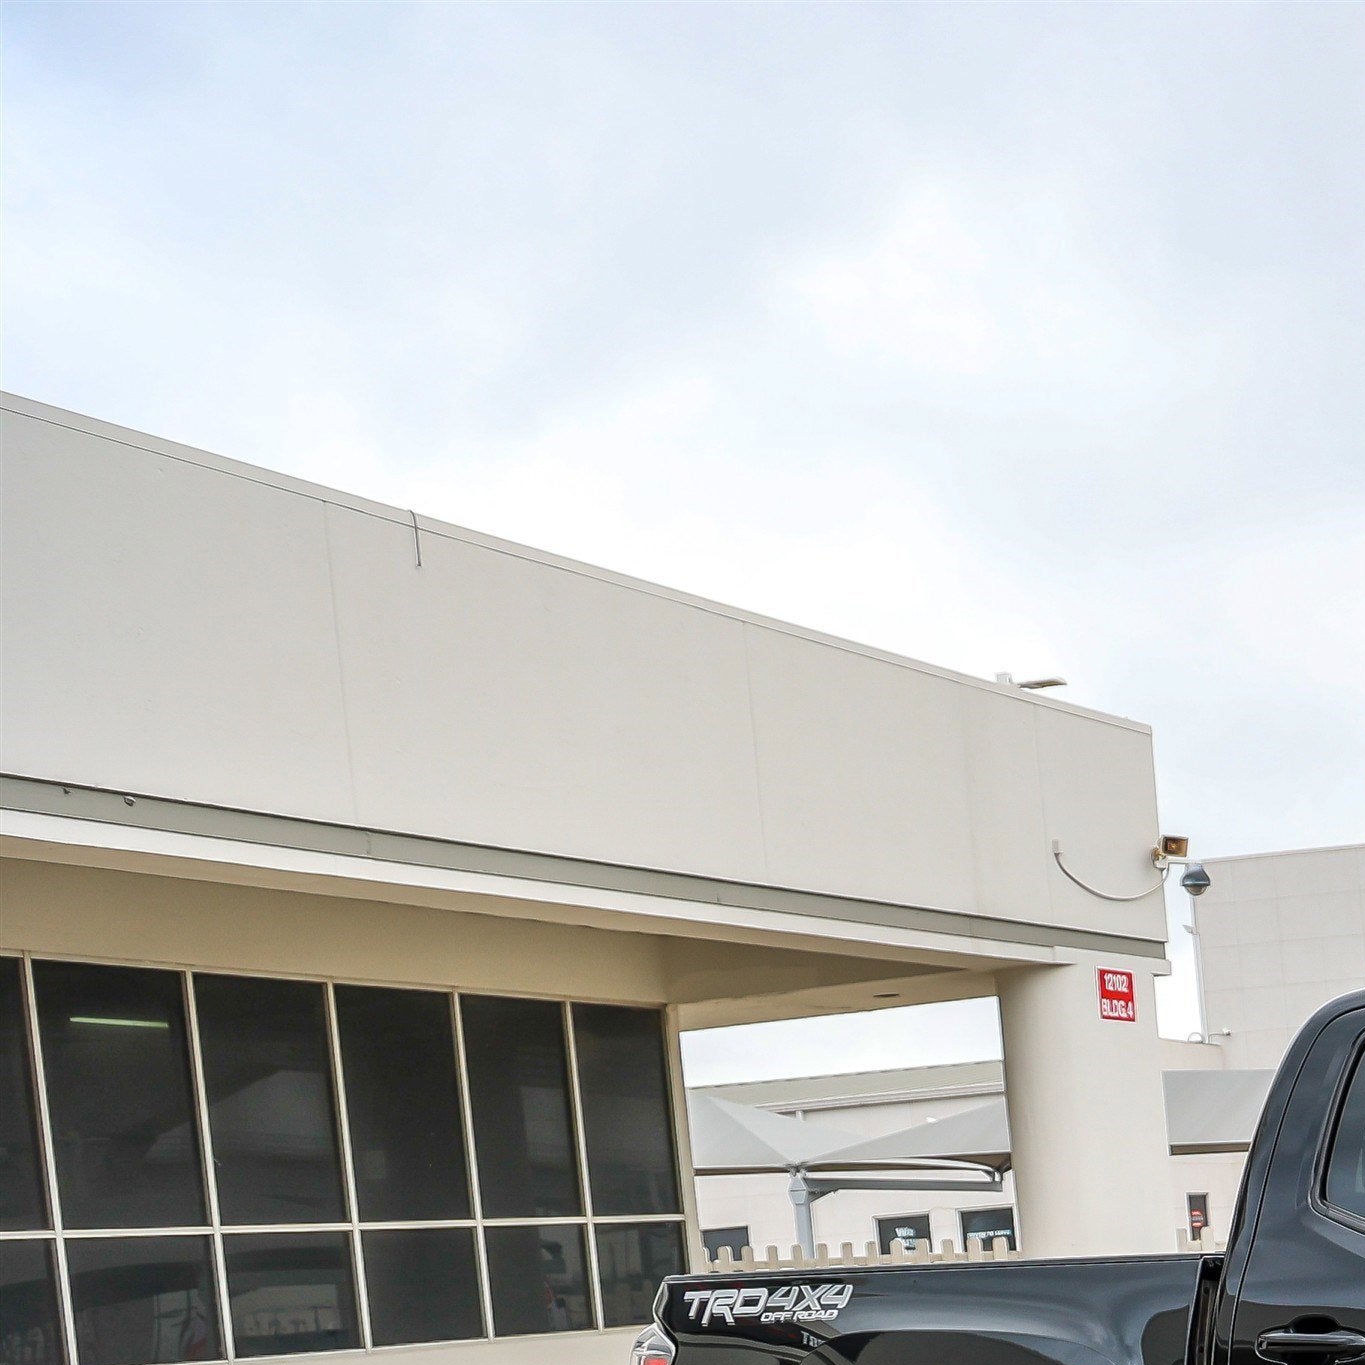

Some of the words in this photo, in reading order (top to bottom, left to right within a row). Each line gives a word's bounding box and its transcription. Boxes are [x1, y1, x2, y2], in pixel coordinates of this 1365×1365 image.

[1104, 973, 1129, 992] 12102
[684, 1287, 768, 1327] TRD
[760, 1310, 794, 1324] OFF
[793, 1309, 839, 1322] ROAD
